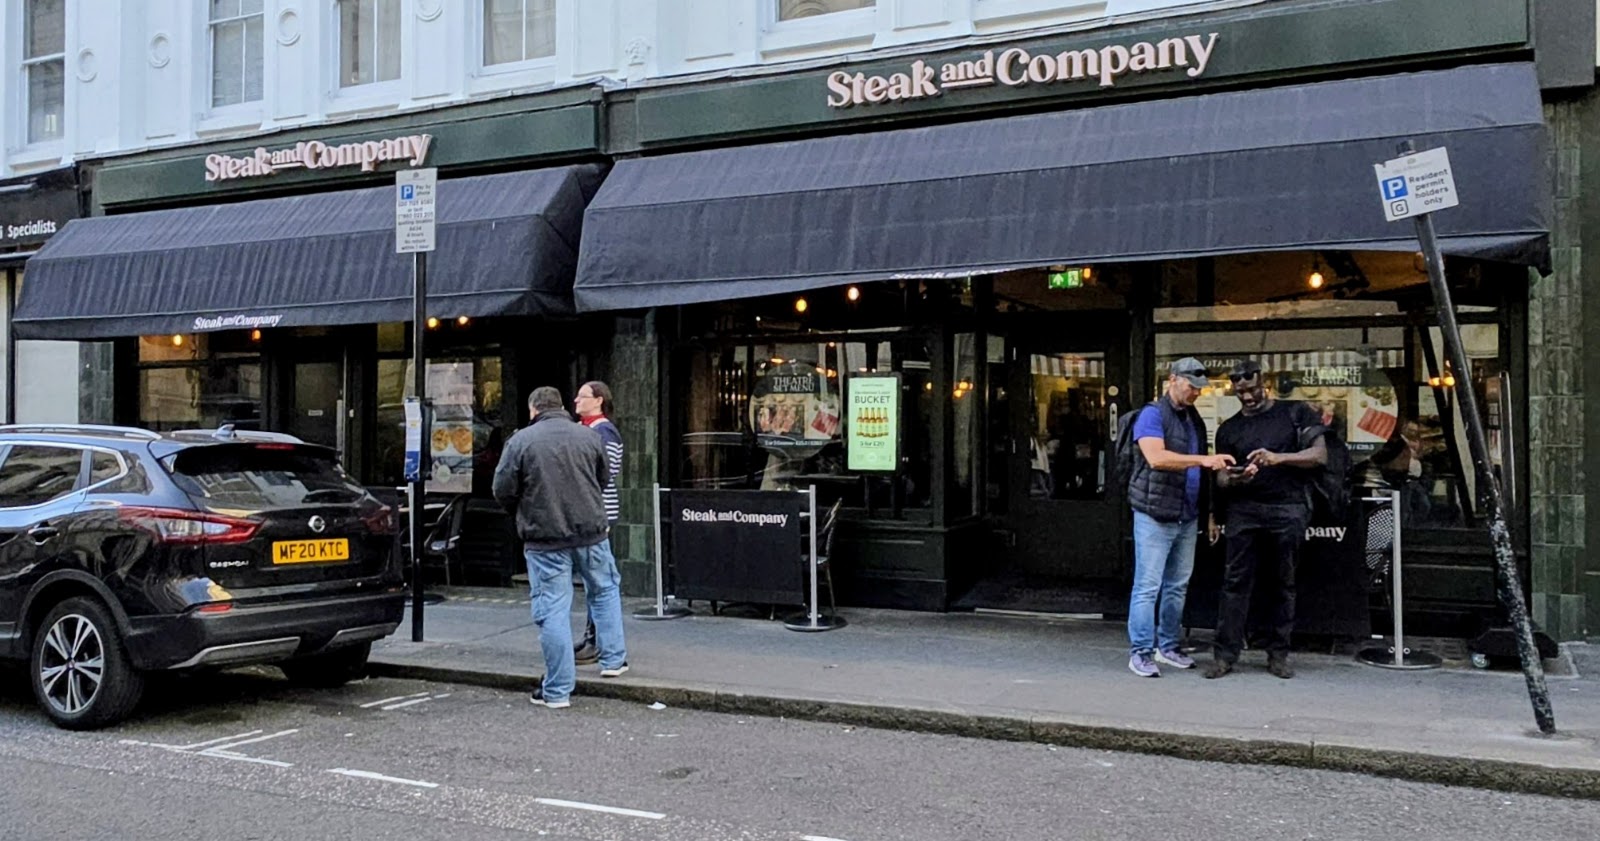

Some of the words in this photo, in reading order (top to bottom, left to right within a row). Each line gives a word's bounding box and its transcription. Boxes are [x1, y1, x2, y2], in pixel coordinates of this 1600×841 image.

[827, 60, 942, 107] Steak
[941, 49, 995, 88] and
[996, 33, 1220, 87] Company
[205, 147, 274, 181] Steak
[271, 142, 304, 168] and
[303, 134, 432, 172] Company
[1409, 168, 1448, 183] Resident
[1415, 178, 1444, 191] permit
[1415, 187, 1449, 199] holders
[1395, 203, 1404, 212] G
[1424, 196, 1443, 206] only
[7, 220, 57, 239] Specialists
[193, 315, 222, 330] Steak
[235, 314, 283, 328] Company
[773, 375, 814, 386] THEATRE
[854, 395, 891, 404] BUCKET
[682, 508, 718, 522] Steak
[717, 510, 734, 522] and
[733, 509, 789, 527] Company
[1305, 526, 1347, 542] pany
[279, 542, 316, 561] MF20
[319, 541, 344, 558] KTC
